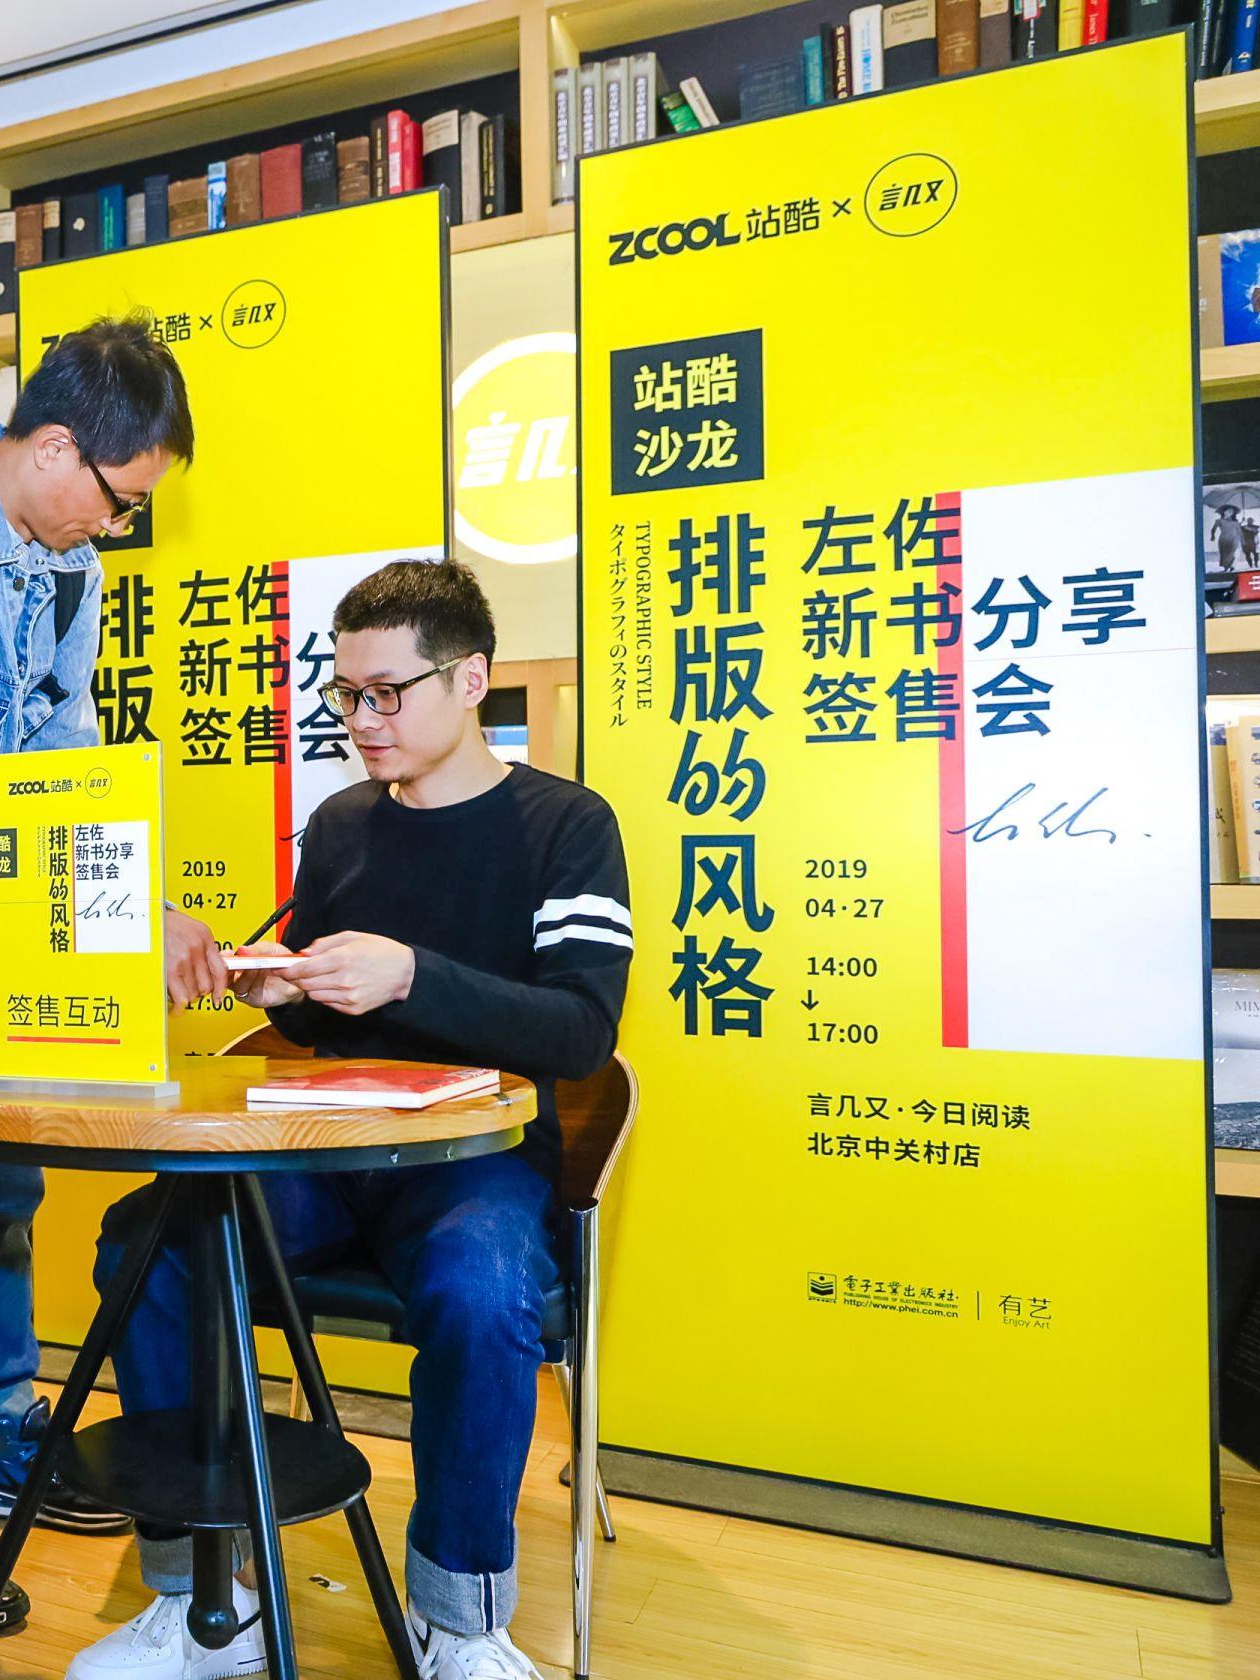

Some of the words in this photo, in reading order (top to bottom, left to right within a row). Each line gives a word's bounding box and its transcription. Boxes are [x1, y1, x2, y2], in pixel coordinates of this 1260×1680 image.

[879, 179, 944, 211] 言几又
[609, 212, 741, 266] ZCOOL
[746, 197, 820, 242] 站酷
[633, 352, 738, 413] 站酷
[459, 411, 577, 489] 言几
[633, 419, 739, 478] 沙龙
[802, 496, 963, 577] 左佐
[178, 564, 290, 628] 左佐
[636, 520, 652, 650] TYPOGRAPHIC
[609, 523, 629, 728] タイポグラフィのスタイル
[801, 565, 1148, 660] 新书分享
[636, 653, 652, 710] STYLE
[803, 663, 1054, 745] 签售会
[180, 703, 349, 766] 签售会
[8, 780, 50, 796] ZCOOL
[50, 779, 73, 793] 站酷
[667, 512, 776, 1039] 排版的风格
[75, 823, 104, 842] 左佐
[75, 842, 134, 861] 新书分享
[182, 861, 226, 877] 2019
[805, 859, 868, 880] 2019
[49, 825, 70, 953] 排版的风格
[75, 863, 120, 881] 签售会
[182, 893, 238, 909] 04·27
[805, 898, 885, 919] 04·27
[806, 956, 878, 978] 14:00
[7, 994, 120, 1028] 签售互动
[807, 1021, 879, 1044] 17:00
[807, 1092, 1031, 1130] 言几又·今日阅读
[808, 1132, 981, 1168] 北京中关村店
[843, 1298, 959, 1318] http://www.phei.com.cn
[999, 1295, 1052, 1319] 有艺
[1003, 1316, 1031, 1329] Enjoy
[1033, 1319, 1051, 1330] Art
